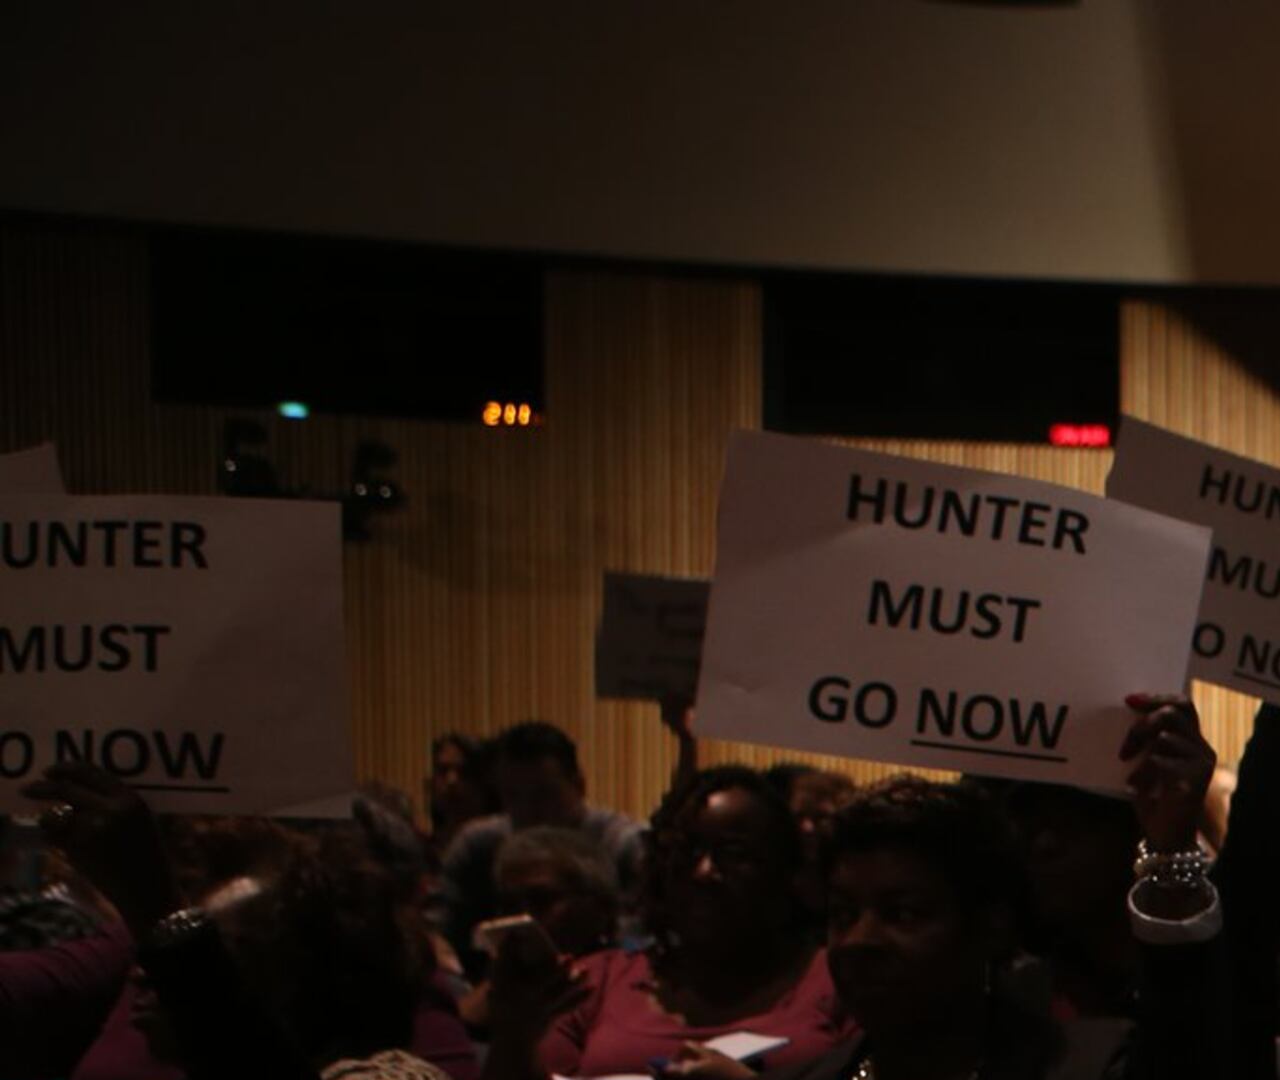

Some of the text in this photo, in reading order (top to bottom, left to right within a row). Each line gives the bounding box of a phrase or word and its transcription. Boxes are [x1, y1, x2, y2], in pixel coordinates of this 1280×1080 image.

[846, 474, 1090, 555] HUNTER
[867, 580, 1042, 643] MUST
[0, 625, 171, 672] MUST
[808, 676, 1070, 753] GO NOW
[55, 730, 226, 781] NOW
